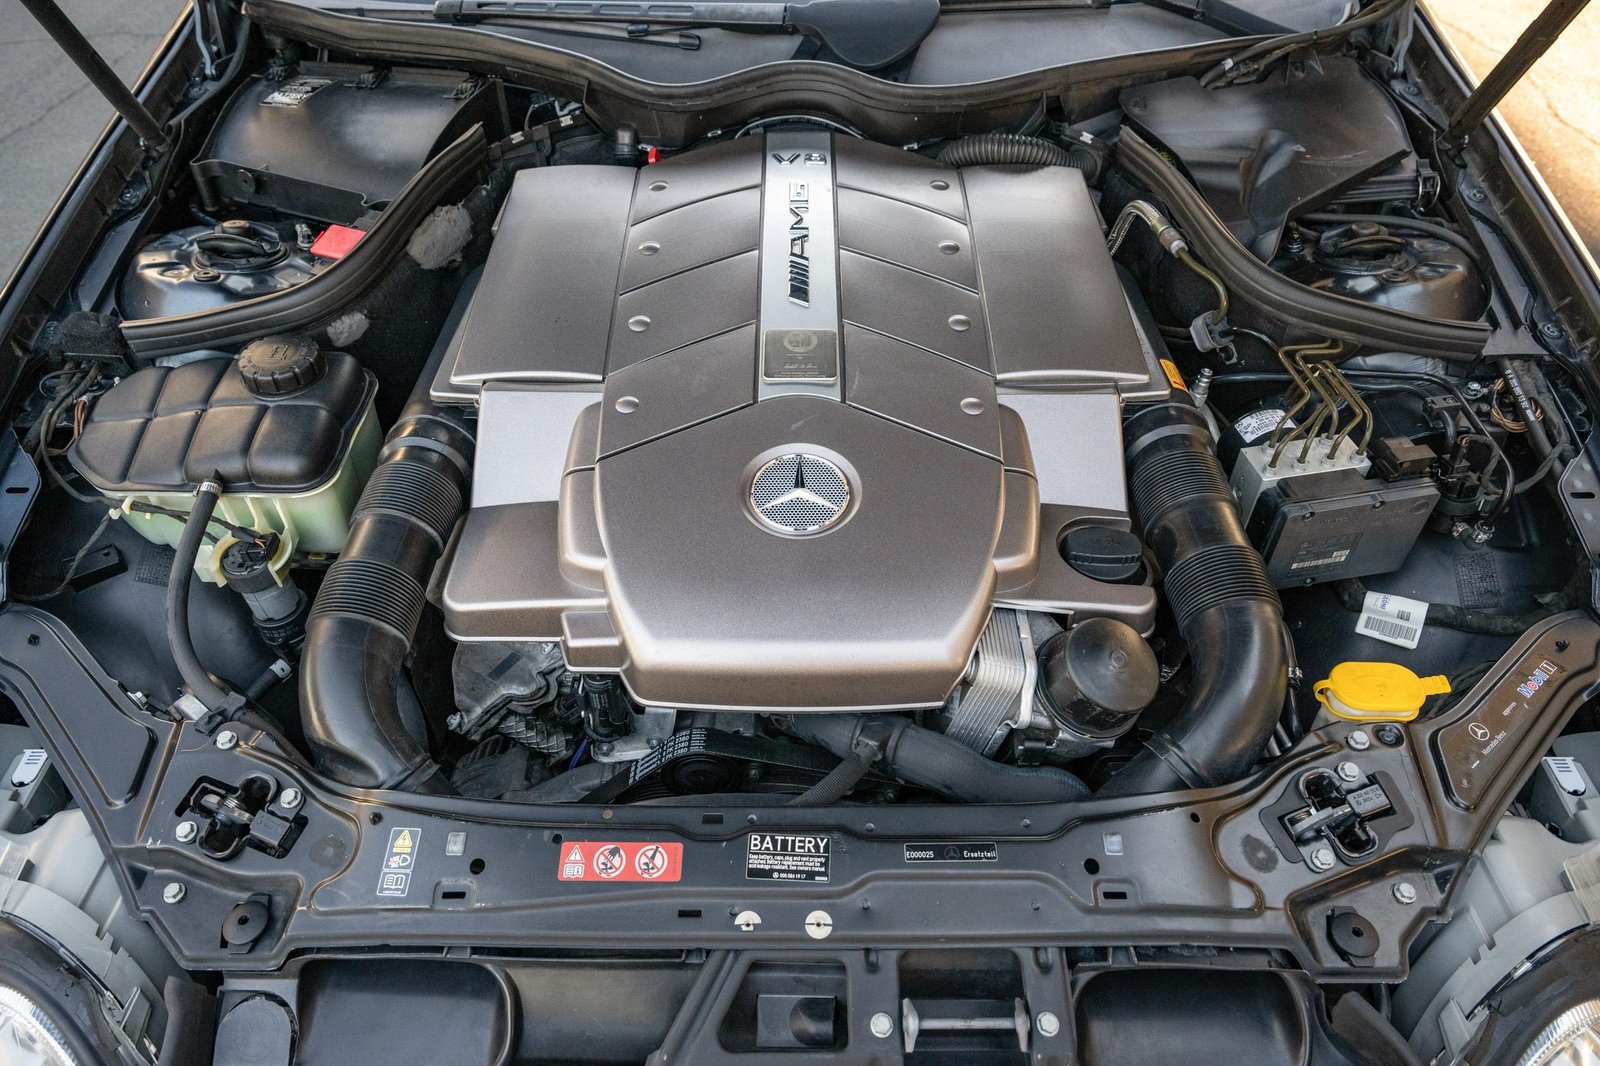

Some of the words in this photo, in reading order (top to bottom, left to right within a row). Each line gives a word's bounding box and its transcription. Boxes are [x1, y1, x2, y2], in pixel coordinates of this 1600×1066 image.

[772, 152, 828, 166] V8
[788, 181, 810, 263] AMG
[1516, 668, 1549, 698] Mobil
[750, 835, 828, 853] BATTERY
[963, 850, 996, 858] Ersatzteil
